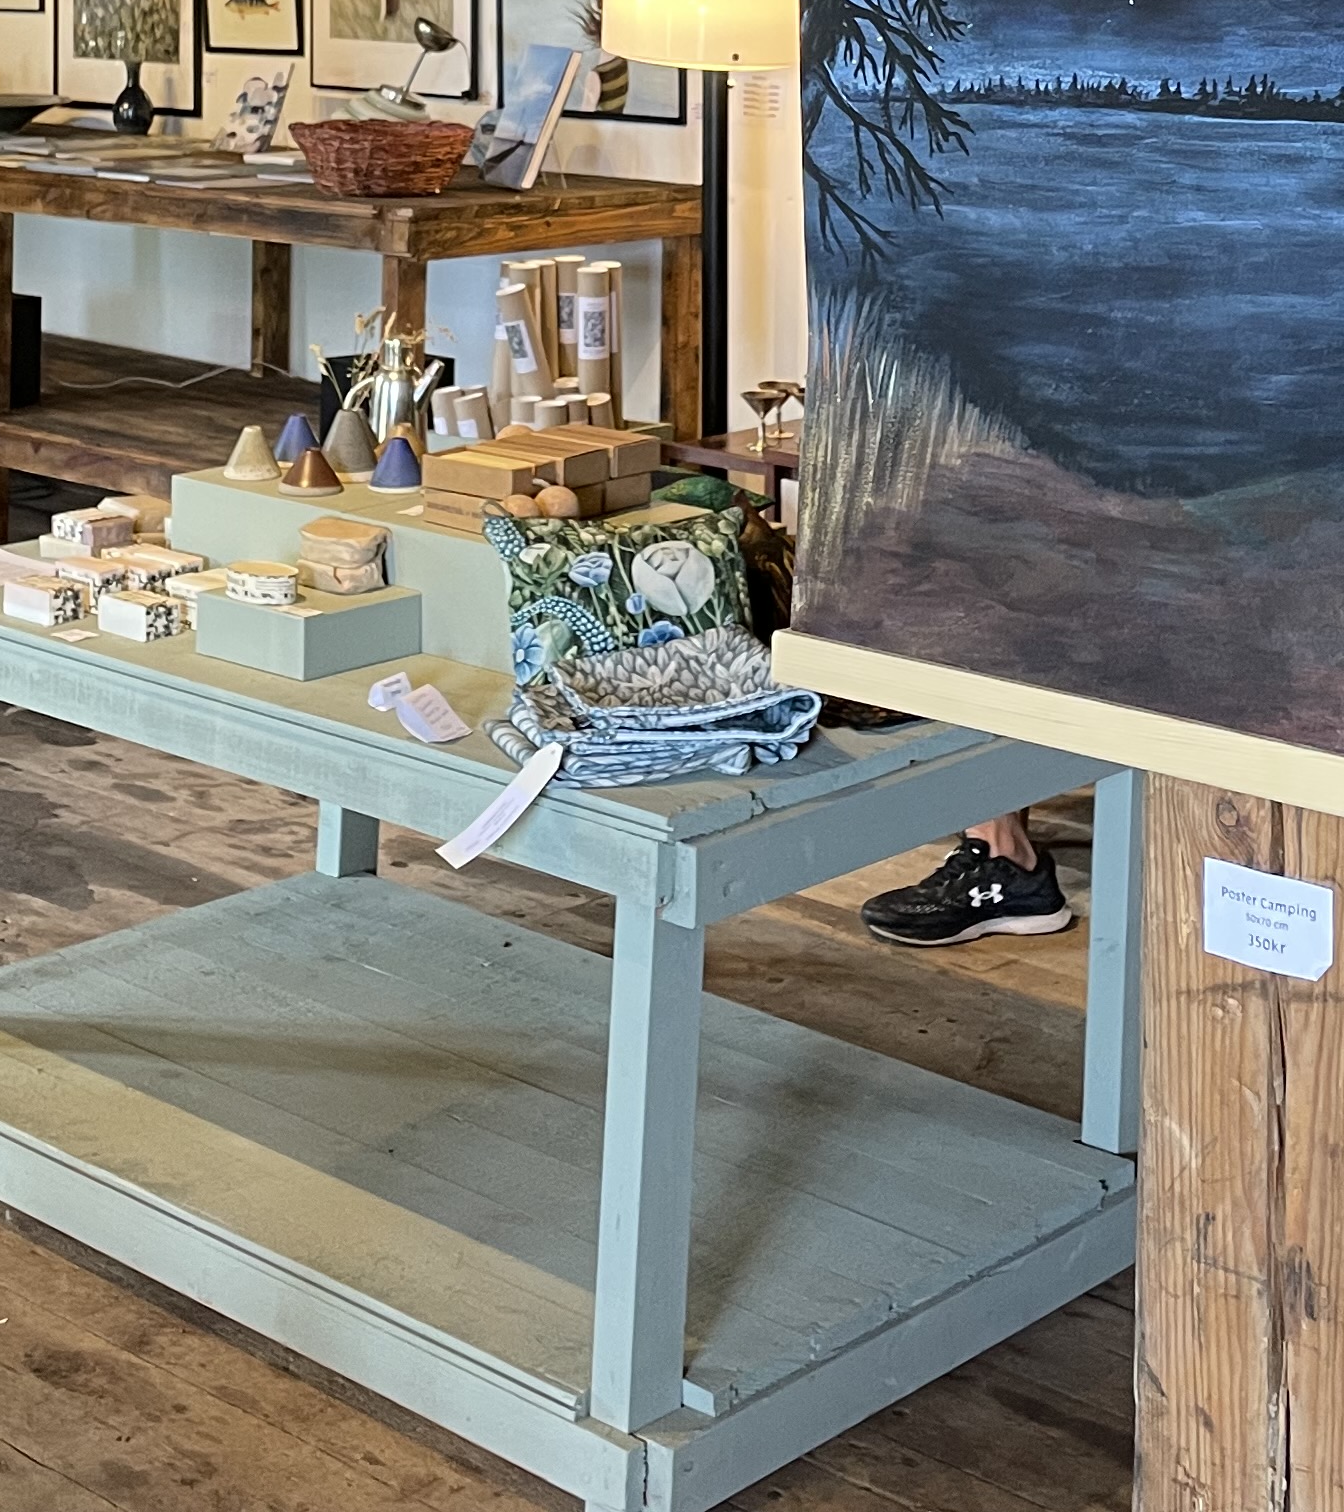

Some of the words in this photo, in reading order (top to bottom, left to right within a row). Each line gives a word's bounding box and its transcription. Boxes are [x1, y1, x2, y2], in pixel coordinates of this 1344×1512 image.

[1221, 886, 1256, 905] Poster
[1260, 897, 1317, 922] Camping
[1273, 921, 1289, 931] cm
[1248, 933, 1287, 954] 350kr
